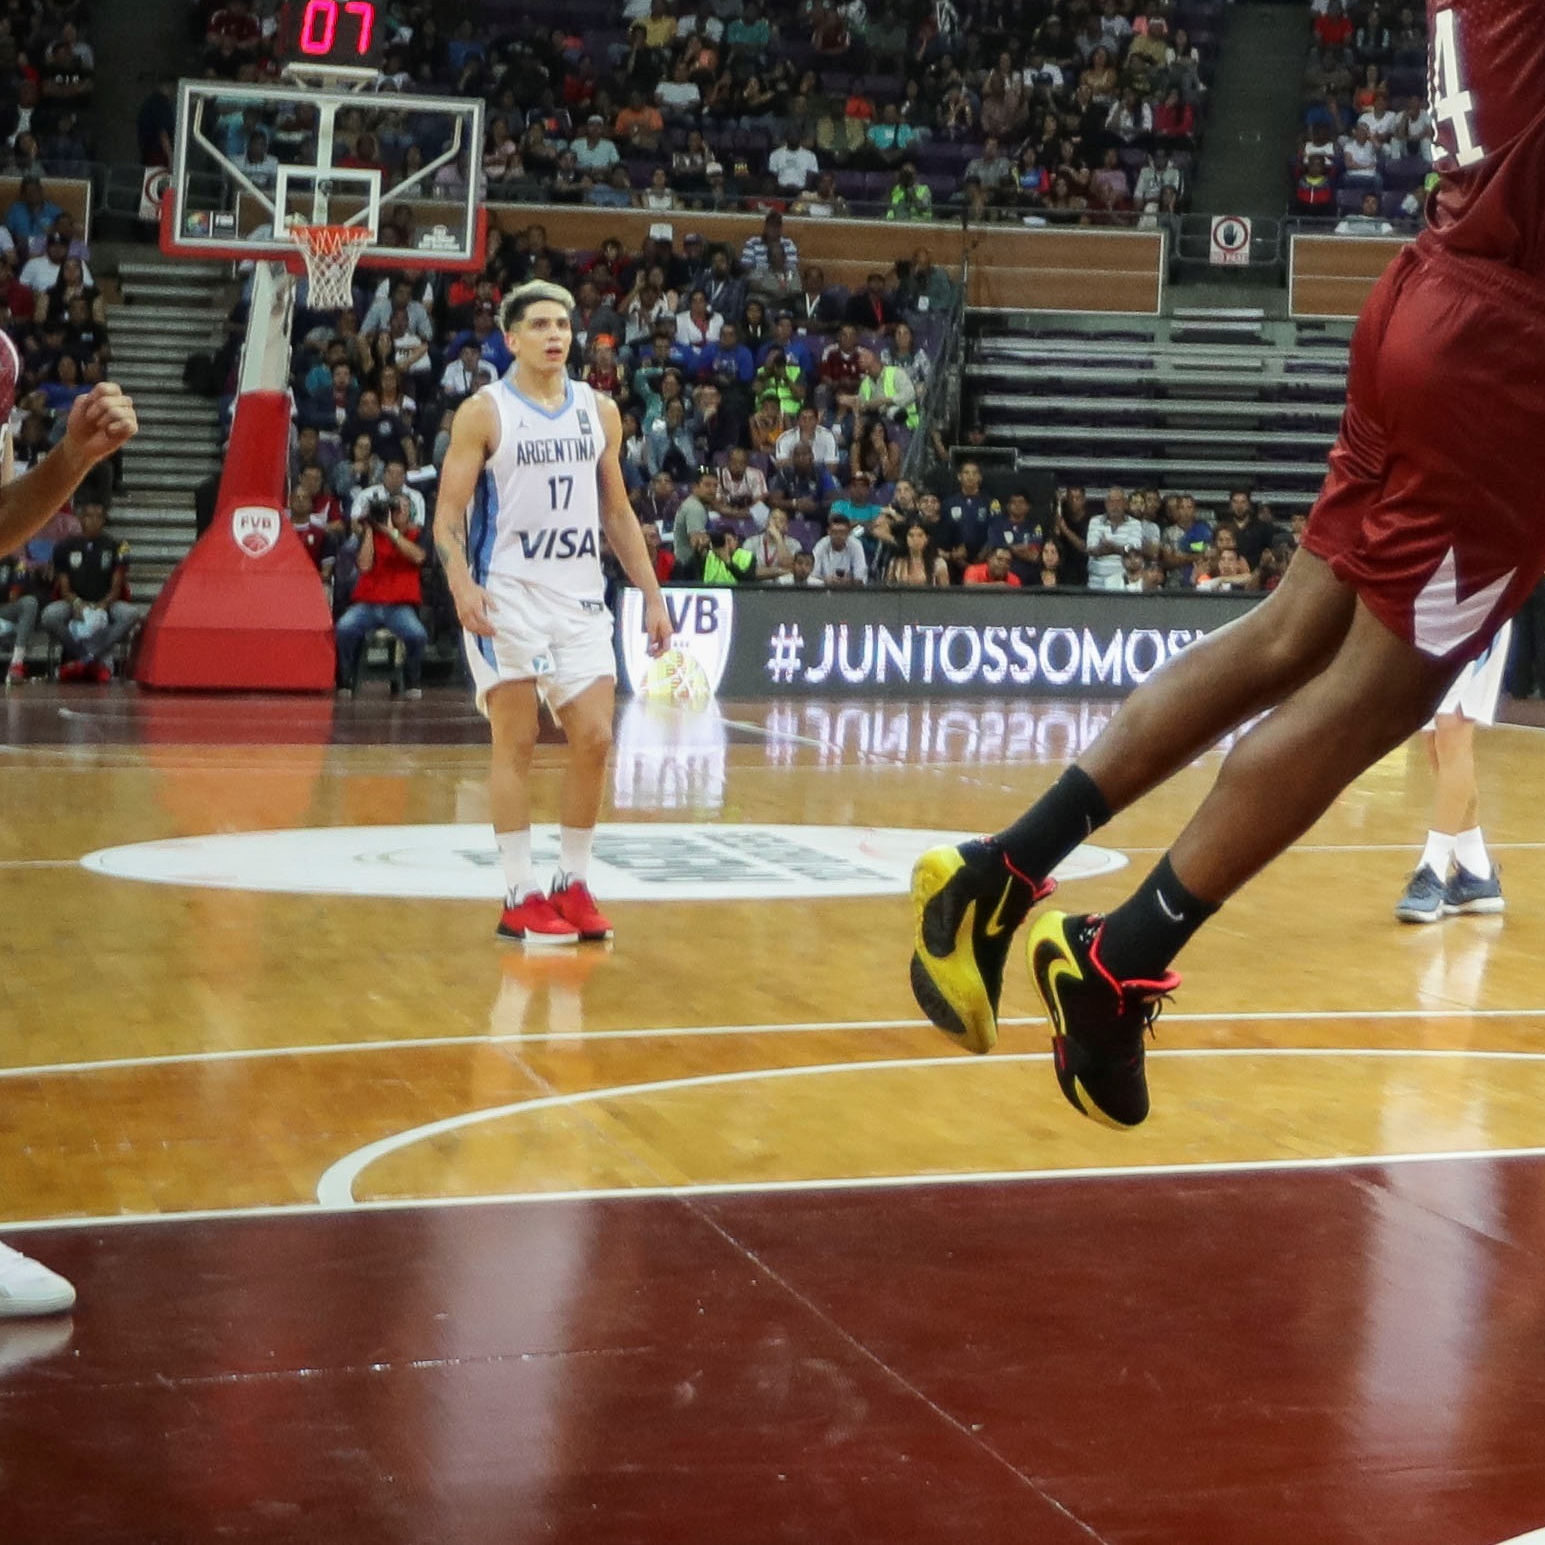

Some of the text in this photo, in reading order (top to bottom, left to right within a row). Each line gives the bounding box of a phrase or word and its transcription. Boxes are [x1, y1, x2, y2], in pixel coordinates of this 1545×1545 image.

[1428, 8, 1486, 168] 4
[516, 437, 597, 467] ARGENTINA
[547, 474, 575, 511] 17
[240, 514, 272, 530] FVB
[514, 527, 598, 560] VISA
[767, 619, 1205, 685] #JUNTOSSOMOS
